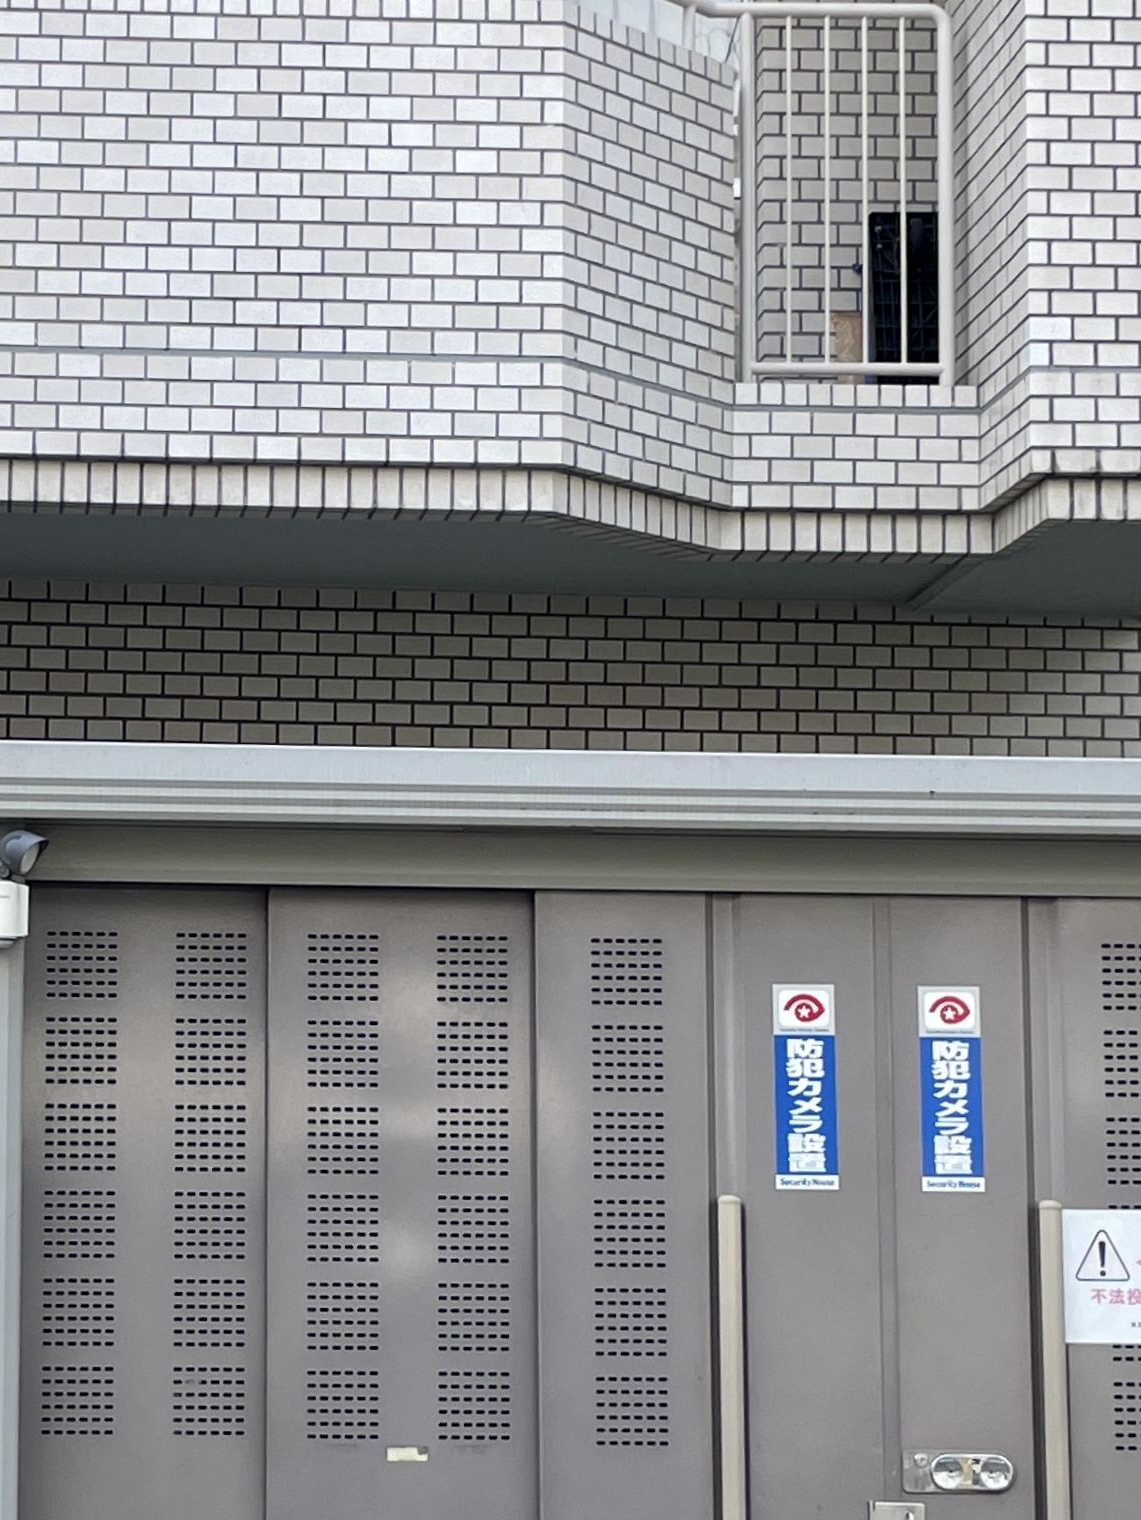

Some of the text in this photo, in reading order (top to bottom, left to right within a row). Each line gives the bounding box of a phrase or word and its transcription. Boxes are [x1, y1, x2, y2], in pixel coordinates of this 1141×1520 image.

[785, 1038, 826, 1173] 防犯カメラ設置
[931, 1041, 973, 1175] 防犯カメラ設置
[779, 1177, 810, 1188] Security
[926, 1179, 957, 1190] Security
